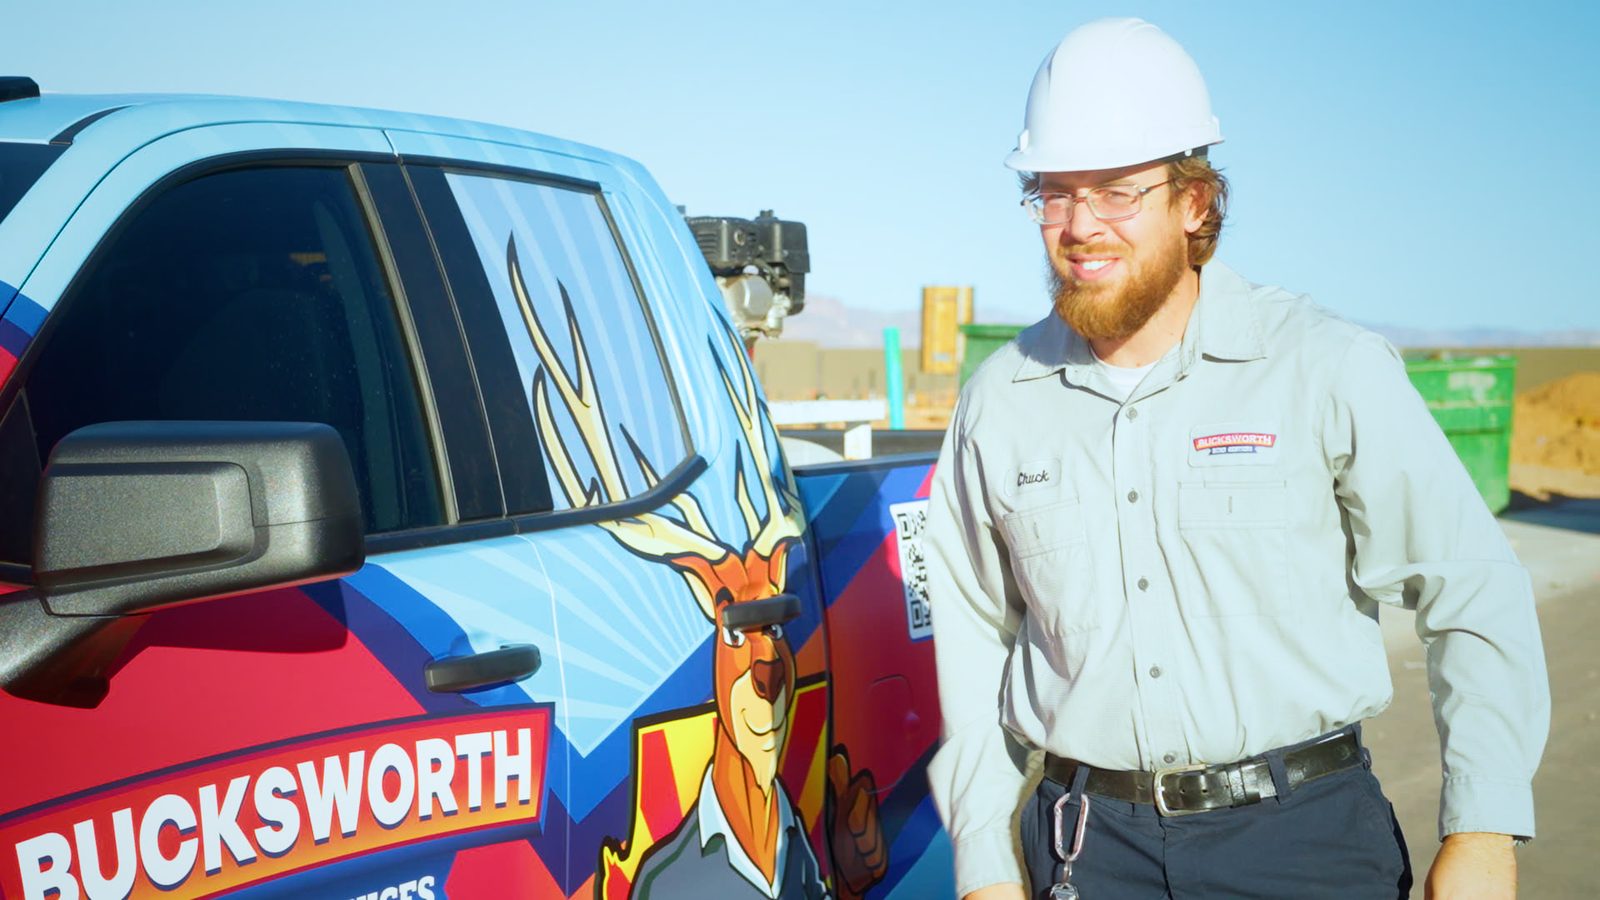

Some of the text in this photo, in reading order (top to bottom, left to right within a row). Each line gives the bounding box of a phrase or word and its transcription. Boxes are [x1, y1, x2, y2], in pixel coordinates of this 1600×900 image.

[1197, 434, 1272, 447] BUCKSWORTH
[1017, 470, 1050, 487] Chuck
[15, 727, 533, 900] BUCKSWORTH
